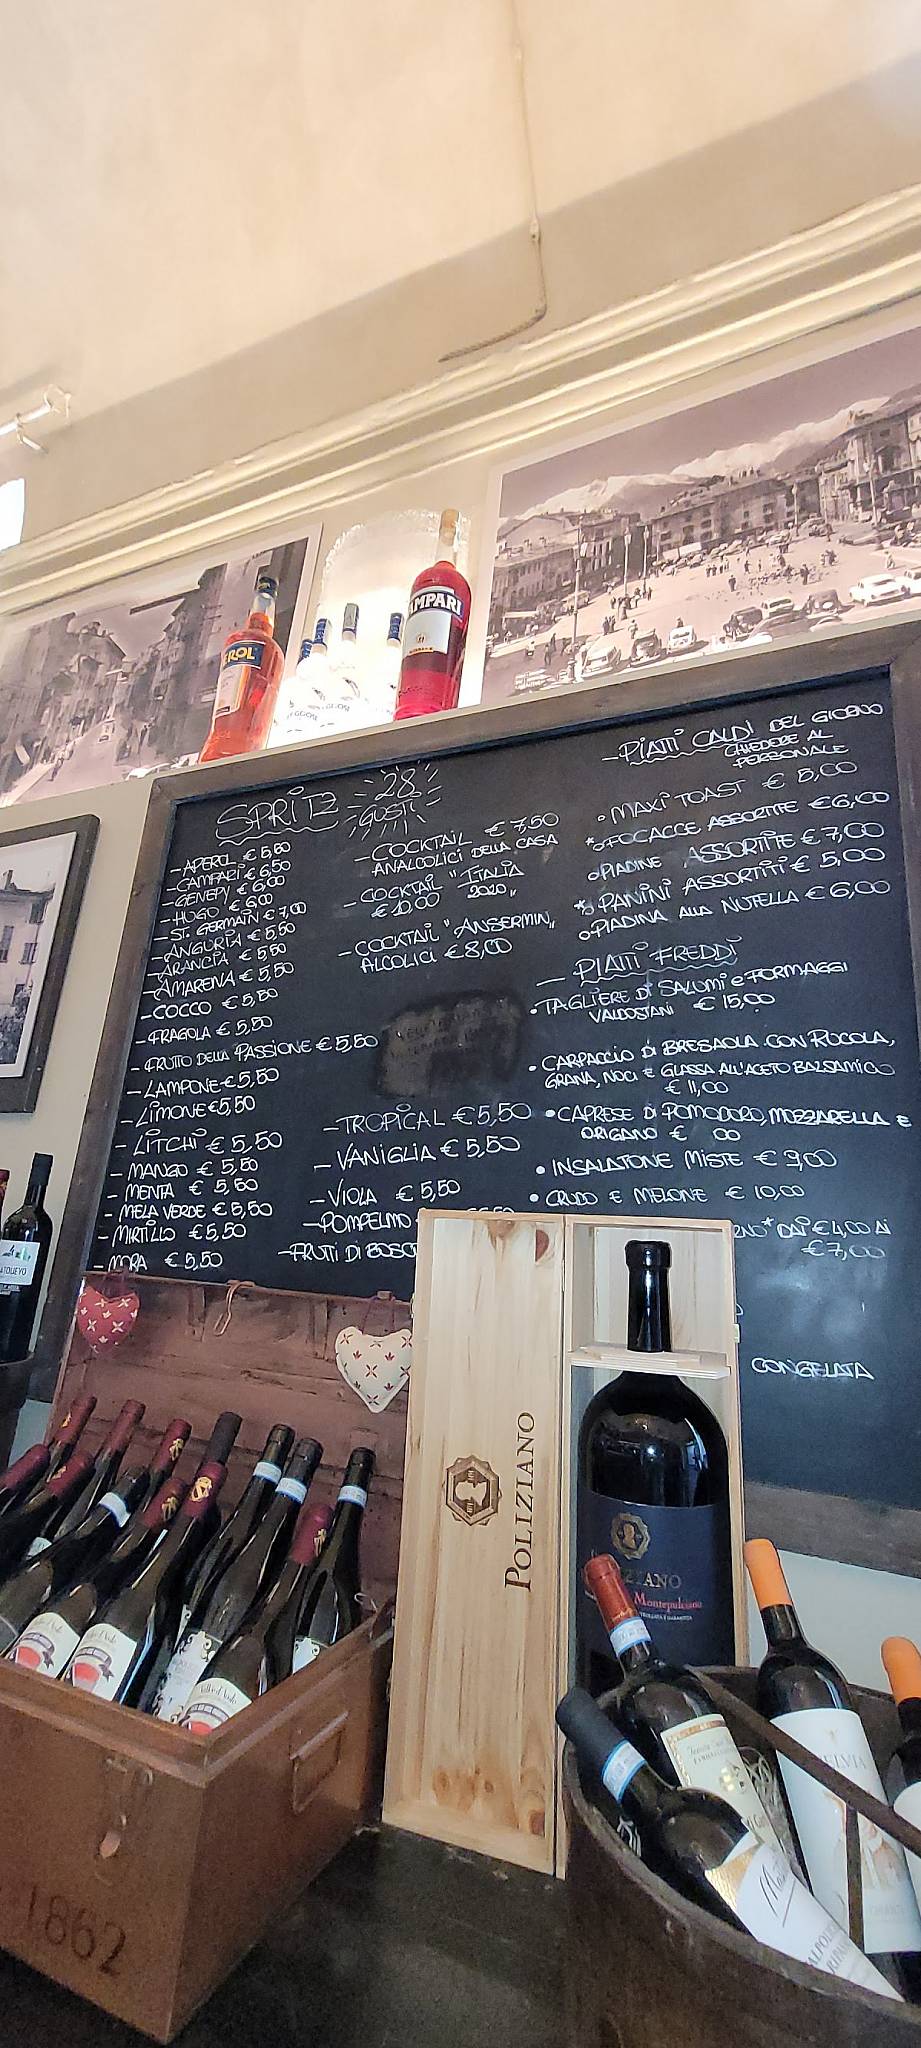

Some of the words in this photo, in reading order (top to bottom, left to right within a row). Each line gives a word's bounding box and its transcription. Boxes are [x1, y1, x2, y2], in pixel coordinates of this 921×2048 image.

[409, 593, 462, 616] AMPARI
[223, 647, 256, 667] EROL
[692, 719, 754, 748] CALDI
[769, 715, 804, 732] DEL
[807, 730, 833, 741] AL
[733, 745, 848, 768] PERSONALE
[375, 768, 416, 800] 28
[611, 792, 671, 824] MAXI
[674, 780, 746, 807] TOAST
[372, 849, 463, 877] ANALCOLICI
[471, 842, 511, 858] DELLA
[516, 834, 558, 848] CASA
[599, 857, 662, 881] PIADINE
[598, 879, 672, 913] PANINI
[682, 856, 788, 895] ASSORTITI
[197, 910, 259, 936] GERMAIN
[591, 908, 668, 938] PIADINA
[679, 905, 713, 919] ALLA
[722, 890, 799, 914] NUTELLA
[360, 948, 437, 973] ALCOLICI
[573, 942, 648, 980] PIATTI
[649, 936, 742, 965] FREDDI
[534, 988, 630, 1015] TAGLIERE
[658, 973, 727, 997] SALUMI
[744, 962, 848, 983] FORMAGGI
[589, 1002, 674, 1023] VALDOSTANI
[197, 1052, 230, 1066] DELLA
[234, 1040, 312, 1062] PASSIONE
[542, 1046, 634, 1071] CARPACCIO
[641, 1038, 656, 1058] DI
[662, 1034, 759, 1056] BRESAOLA
[766, 1034, 807, 1048] CON
[603, 1070, 638, 1084] NOCI
[661, 1063, 715, 1077] GLASSA
[793, 1059, 895, 1075] BALSAMICO
[557, 1105, 634, 1122] CAPRESE
[644, 1104, 657, 1120] DI
[581, 1126, 657, 1141] ORIGANO
[337, 1143, 436, 1172] VANIGLIA
[552, 1153, 673, 1176] INSALATONE
[684, 1149, 743, 1170] MISTE
[125, 1183, 174, 1201] MENTA
[328, 1179, 377, 1207] VIOLA
[546, 1190, 598, 1207] CRUDO
[634, 1187, 708, 1205] MELONE
[119, 1204, 159, 1222] MELA
[163, 1205, 206, 1219] VERDE
[345, 1240, 361, 1262] DI
[751, 1358, 874, 1380] CONGELATA
[504, 1412, 535, 1592] POLIZIANO
